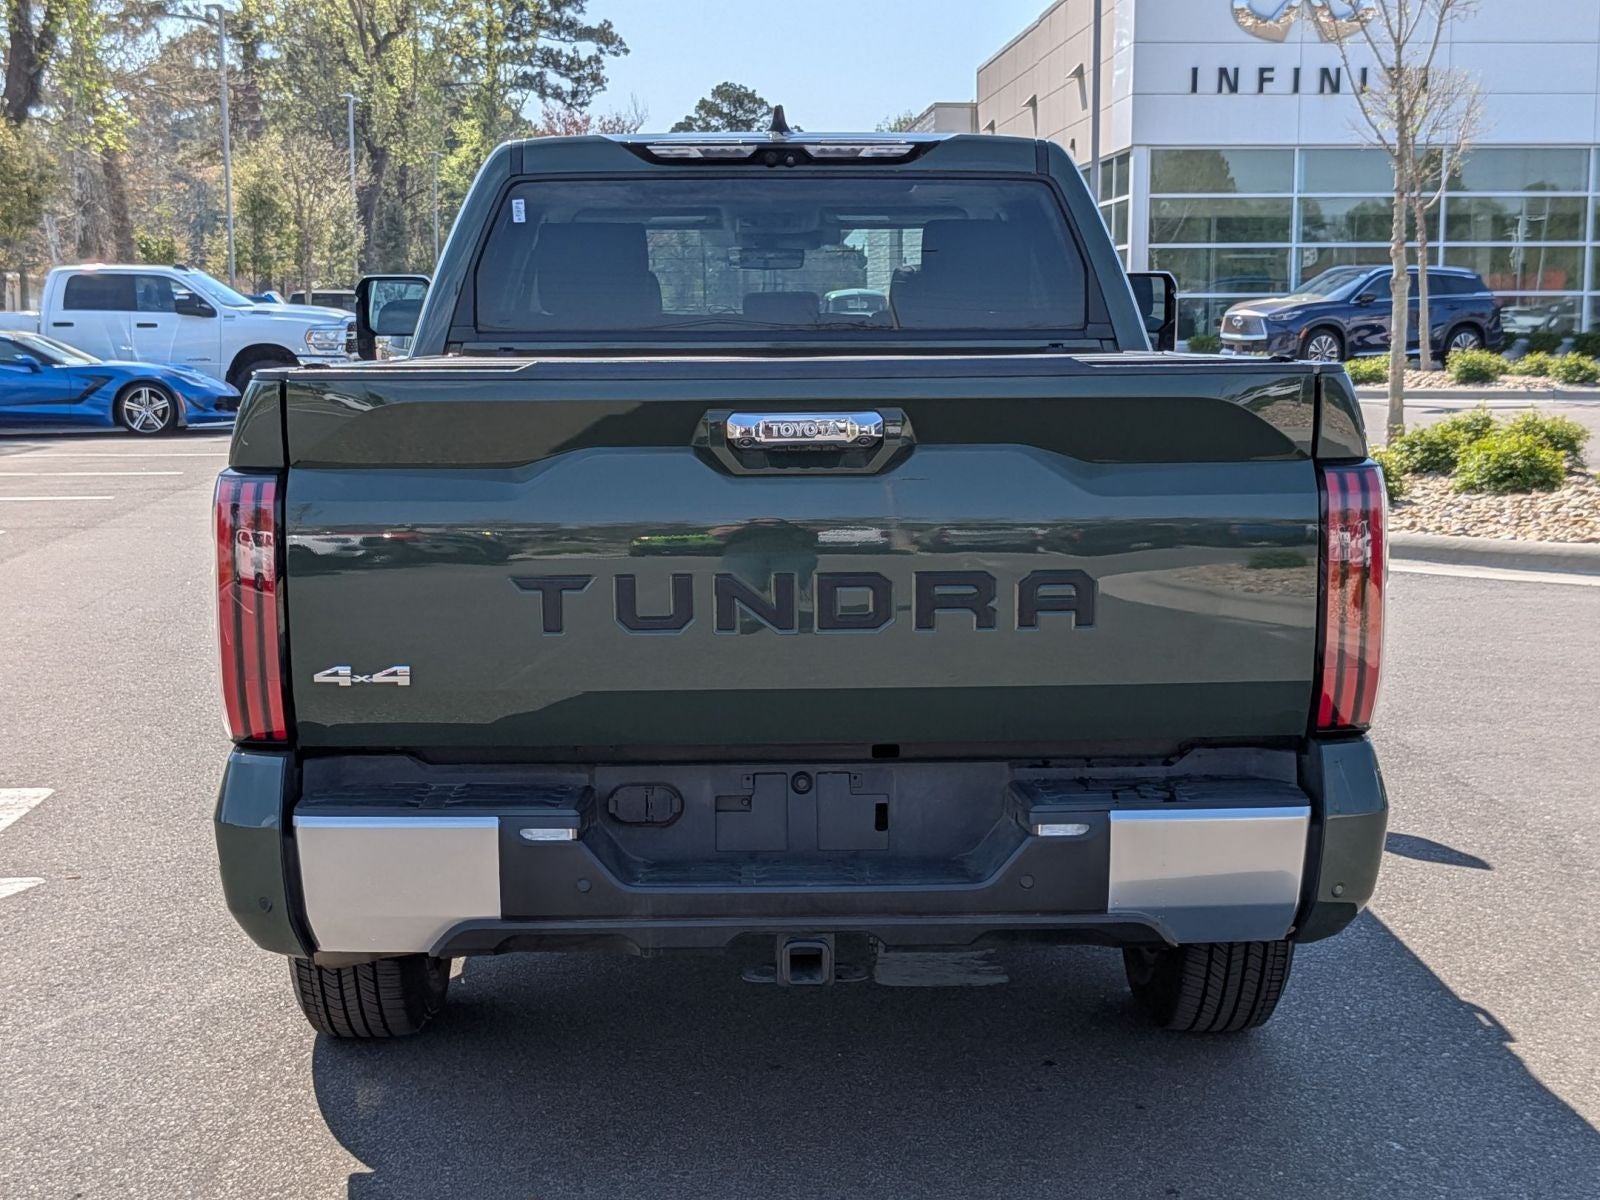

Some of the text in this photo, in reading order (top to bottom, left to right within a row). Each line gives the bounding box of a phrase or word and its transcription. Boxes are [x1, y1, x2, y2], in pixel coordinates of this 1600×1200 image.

[1190, 66, 1429, 95] INFINI
[769, 422, 841, 437] TOYOTA
[508, 570, 1096, 635] TUNDRA
[313, 665, 411, 687] 4x4
